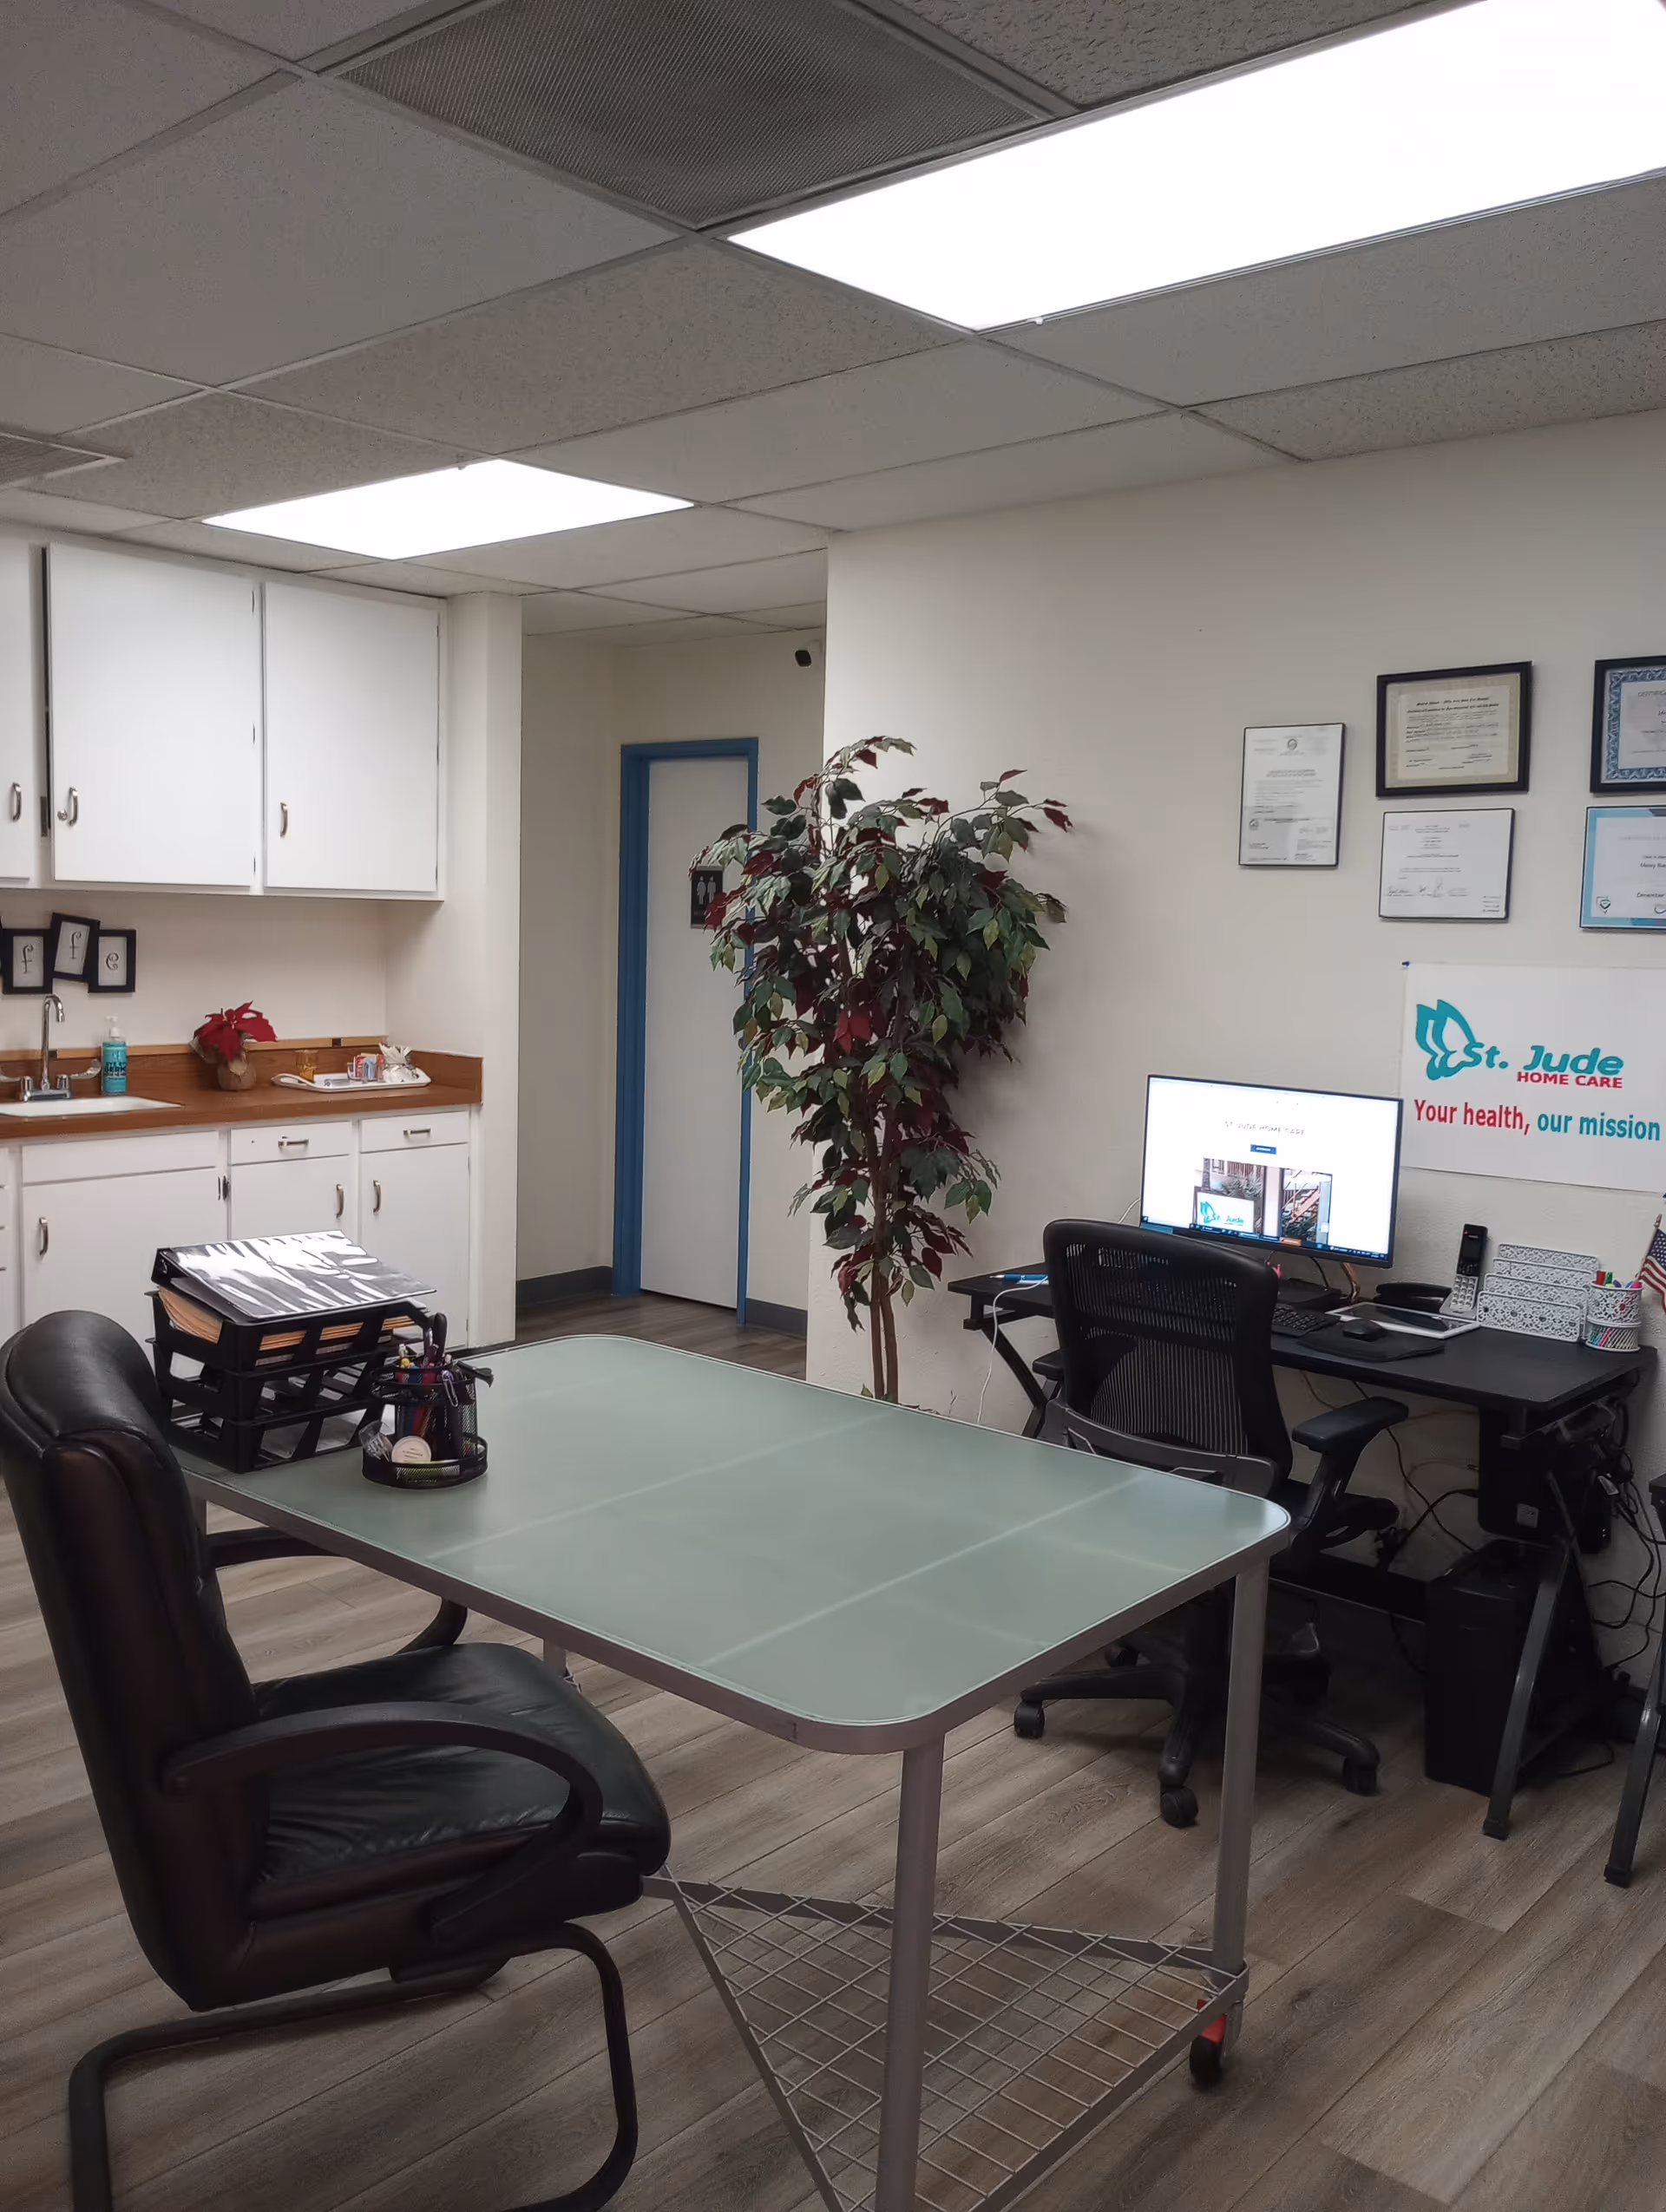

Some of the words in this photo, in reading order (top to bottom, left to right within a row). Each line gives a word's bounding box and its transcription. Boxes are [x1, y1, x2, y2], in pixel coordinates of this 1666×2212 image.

[22, 945, 34, 974] f
[69, 931, 82, 959] f
[1463, 1042, 1509, 1070] St.
[1523, 1045, 1624, 1076] Jude
[1517, 1071, 1570, 1085] HOME
[1575, 1075, 1623, 1089] CARE
[1414, 1099, 1458, 1124] Your
[1463, 1102, 1531, 1135] health,
[1537, 1112, 1573, 1134] our
[1578, 1111, 1661, 1141] mission
